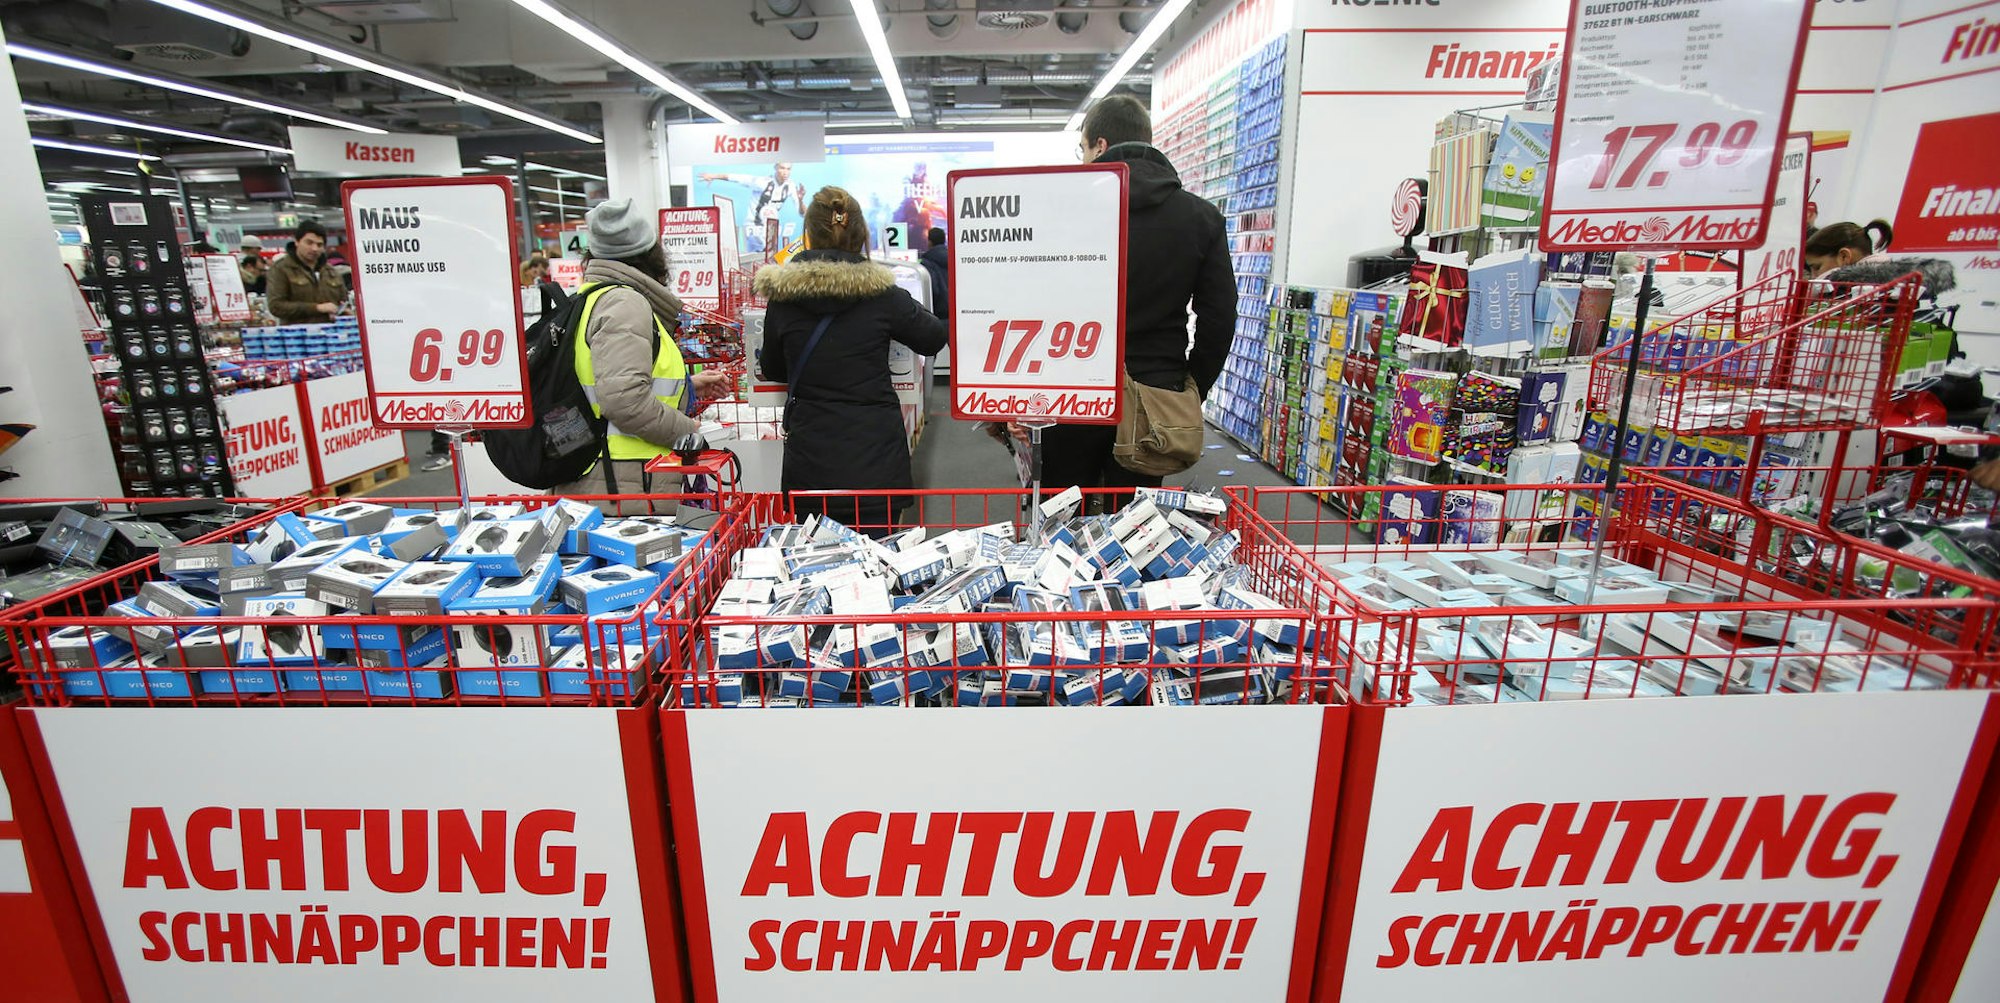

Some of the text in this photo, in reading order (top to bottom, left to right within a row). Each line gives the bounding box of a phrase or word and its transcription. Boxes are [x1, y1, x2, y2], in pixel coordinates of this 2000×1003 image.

[1583, 20, 1609, 30] 37622
[1611, 18, 1622, 27] BT
[345, 141, 415, 164] Kassen
[714, 134, 780, 154] Kassen
[1588, 120, 1758, 189] 17.99
[1780, 153, 1803, 171] CKER
[360, 206, 421, 230] MAUS
[960, 195, 1020, 219] AKKU
[885, 227, 899, 246] 2
[960, 228, 1033, 243] ANSMANN
[1550, 215, 1757, 243] Media Markt
[1947, 226, 1997, 242] ab 6 bis
[363, 238, 420, 254] VIVANCO
[568, 235, 580, 251] 4
[664, 238, 686, 246] PUTTY
[365, 262, 446, 274] 36637 MAUS USB
[677, 270, 714, 294] 9.99
[1488, 280, 1502, 330] GLÜCK-
[1506, 272, 1520, 331] WUNSCH
[409, 328, 505, 383] 6.99
[982, 320, 1102, 373] 17.99
[321, 397, 370, 432] ACHTU
[380, 399, 524, 422] Media Markt
[959, 391, 1113, 416] Media Markt
[598, 544, 625, 556] VIVANCO
[604, 587, 646, 602] VIVANCO
[1391, 792, 1899, 893] ACHTUNG,
[123, 807, 607, 907] ACHTUNG,
[741, 809, 1267, 907] ACHTUNG,
[141, 905, 610, 969] SCHNÄPPCHEN!
[744, 911, 1256, 972] SCHNÄPPCHEN!
[1376, 899, 1881, 969] SCHNÄPPCHEN!
